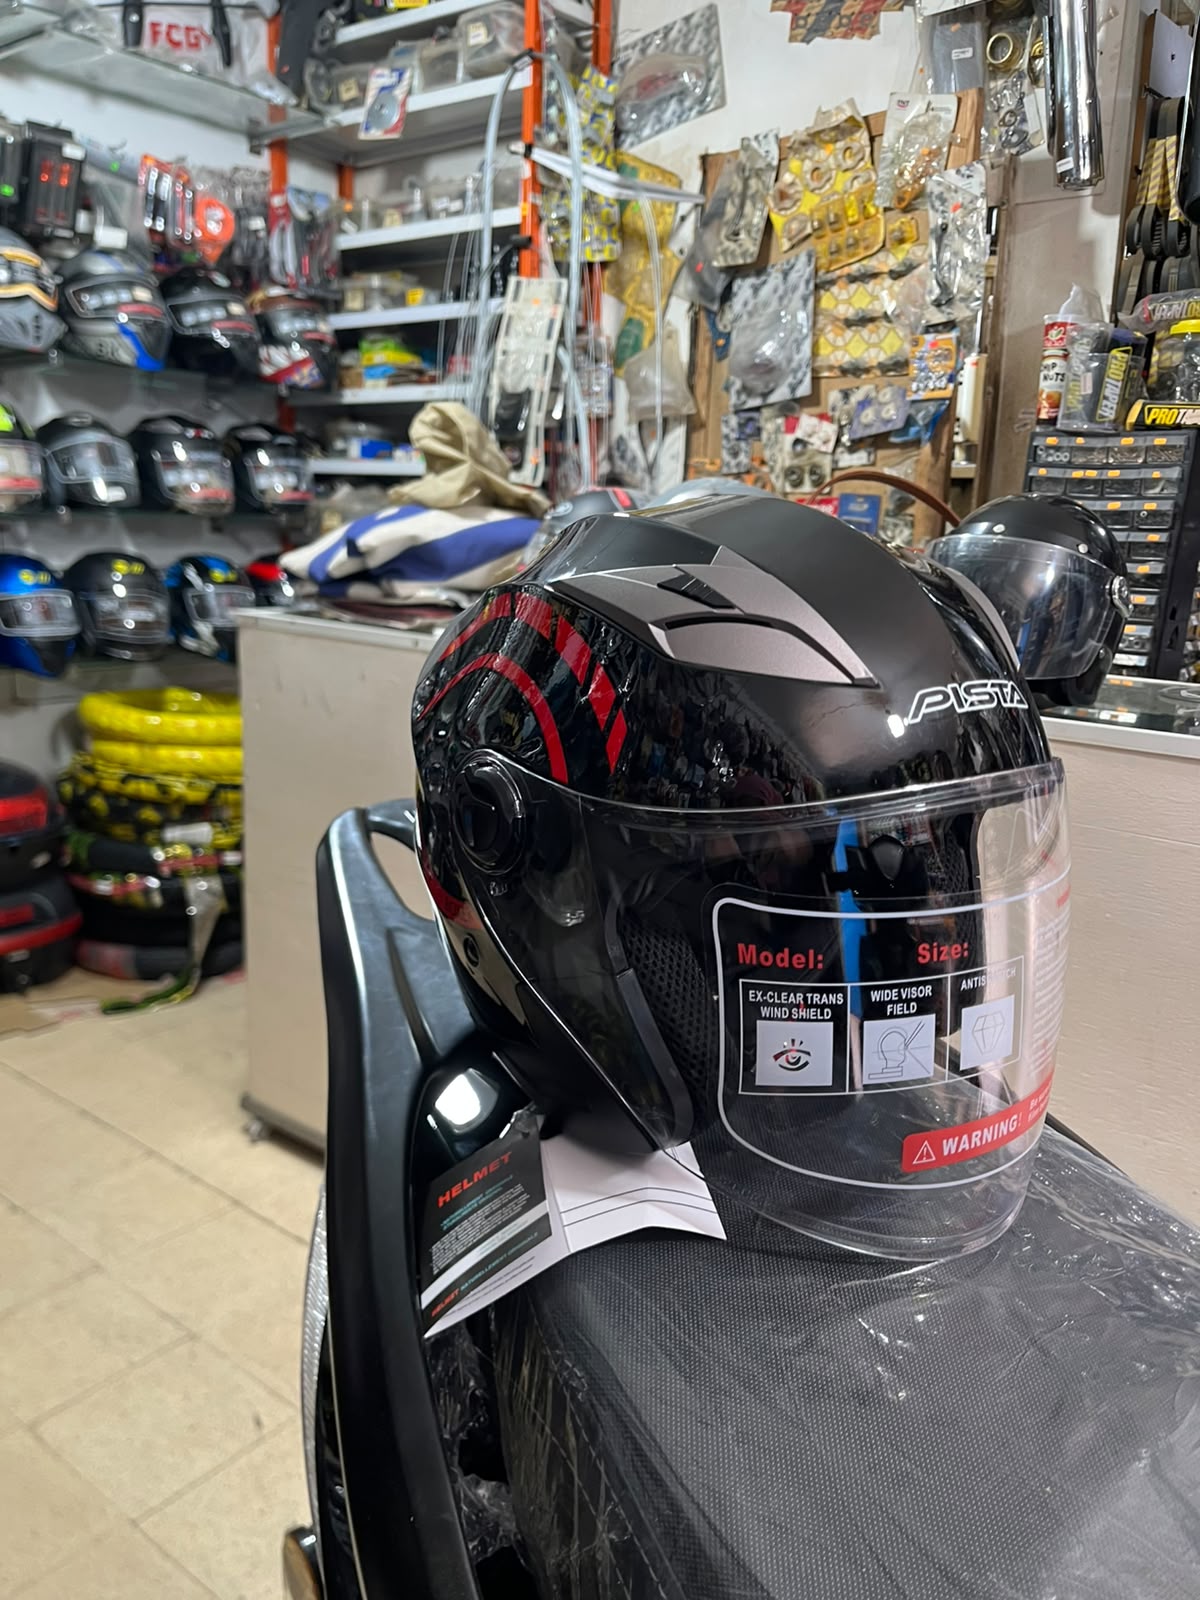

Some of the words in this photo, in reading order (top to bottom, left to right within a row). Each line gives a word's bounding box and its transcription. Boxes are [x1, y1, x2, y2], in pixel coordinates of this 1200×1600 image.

[1099, 351, 1129, 419] PROTAPER
[908, 679, 1029, 724] PISTA
[737, 943, 824, 970] Model:
[917, 942, 969, 964] Size:
[748, 990, 804, 1004] EX-CLEAR
[806, 993, 844, 1005] TRANS
[870, 989, 899, 1002] WIDE
[900, 985, 933, 999] VISOR
[760, 1006, 789, 1018] WIND
[791, 1008, 832, 1020] SHIELD
[886, 1002, 918, 1016] FIELD
[942, 1111, 1022, 1156] WARNING!
[437, 1151, 512, 1208] HELMET
